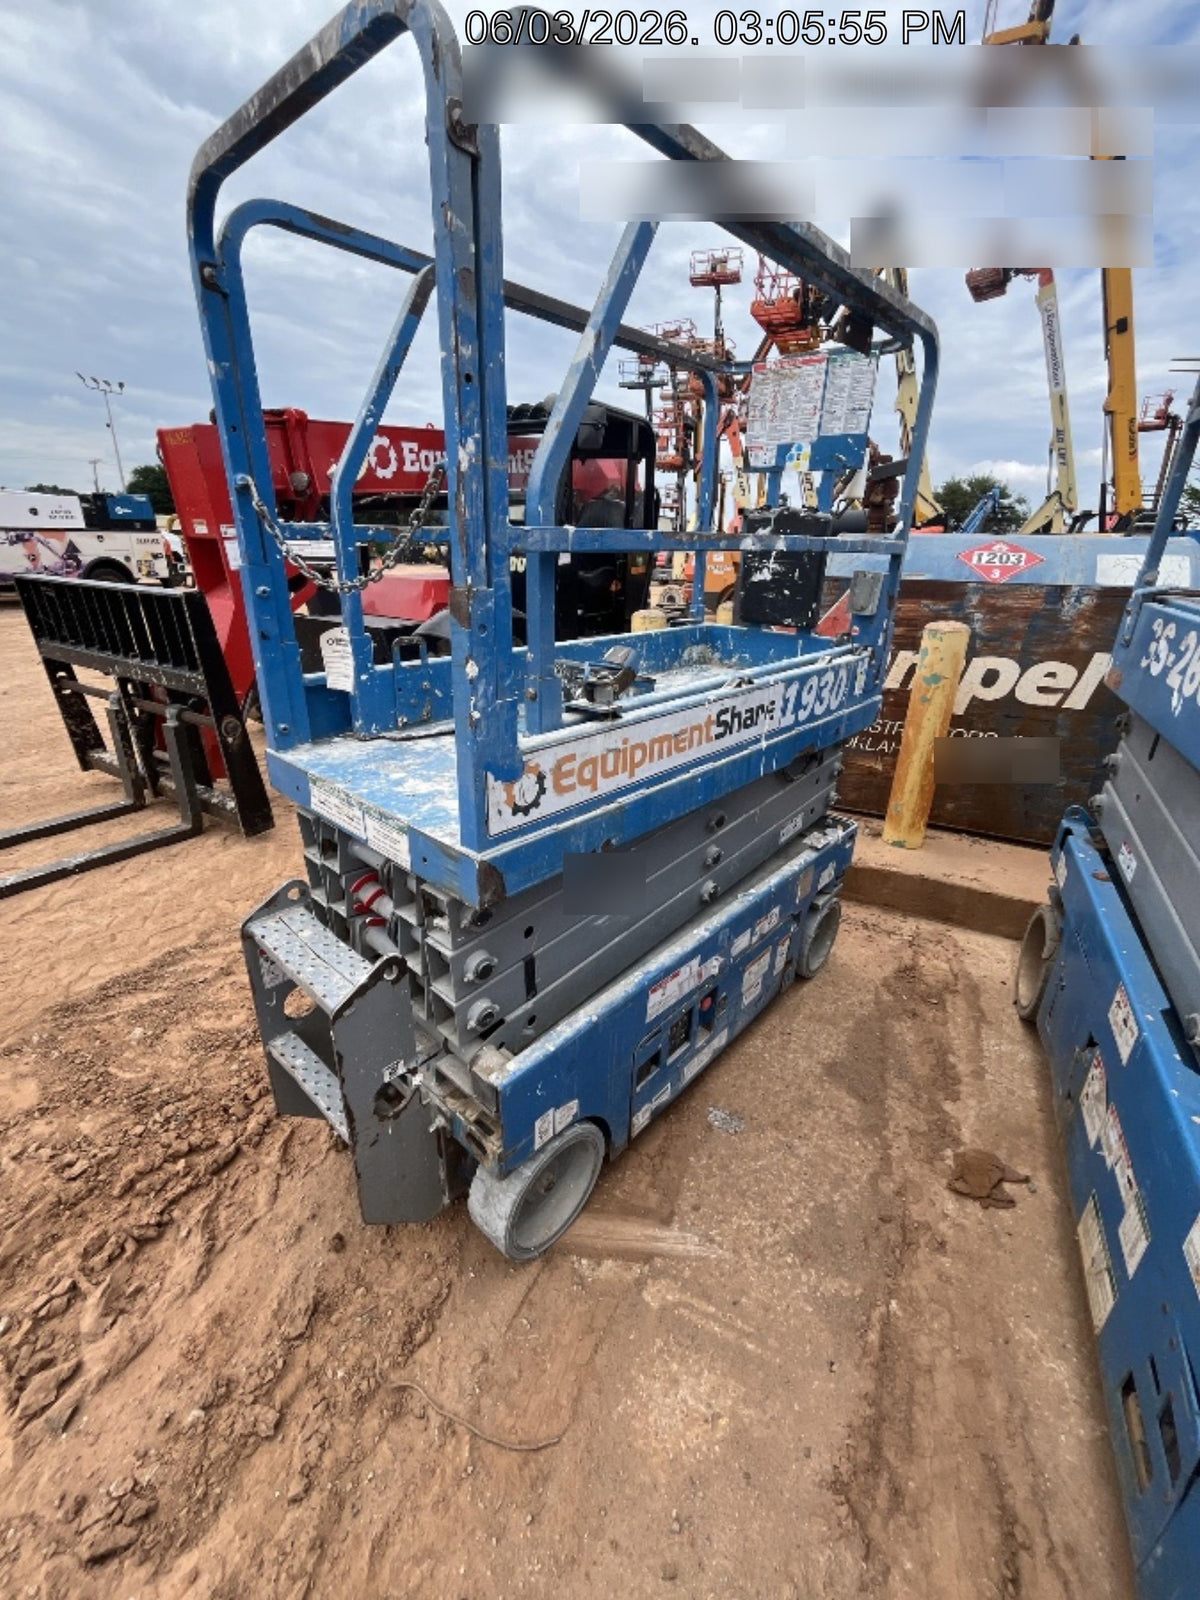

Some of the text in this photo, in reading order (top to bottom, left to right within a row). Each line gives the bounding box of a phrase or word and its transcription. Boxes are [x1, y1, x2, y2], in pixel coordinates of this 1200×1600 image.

[975, 552, 1024, 566] 1203
[990, 568, 1001, 579] 3
[553, 700, 776, 797] EquipmentShare
